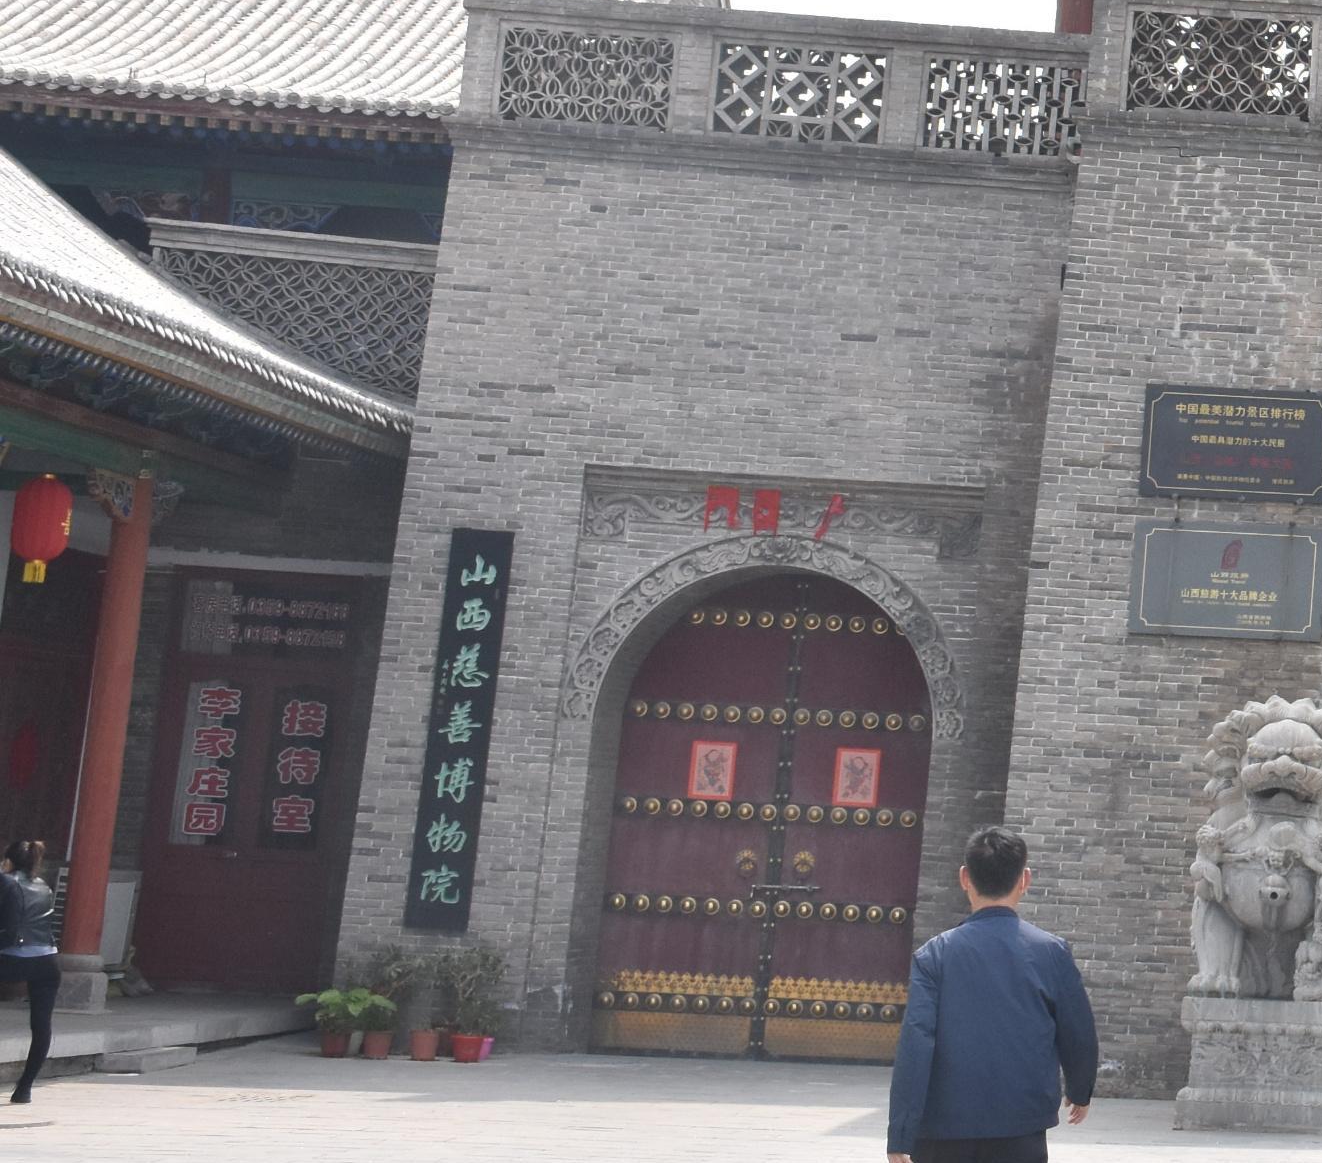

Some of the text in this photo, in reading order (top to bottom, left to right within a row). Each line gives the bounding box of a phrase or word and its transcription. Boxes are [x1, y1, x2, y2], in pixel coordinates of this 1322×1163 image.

[183, 686, 242, 835] 李家庄园
[272, 699, 328, 833] 接待室
[420, 553, 497, 904] 山西慈善博物院
